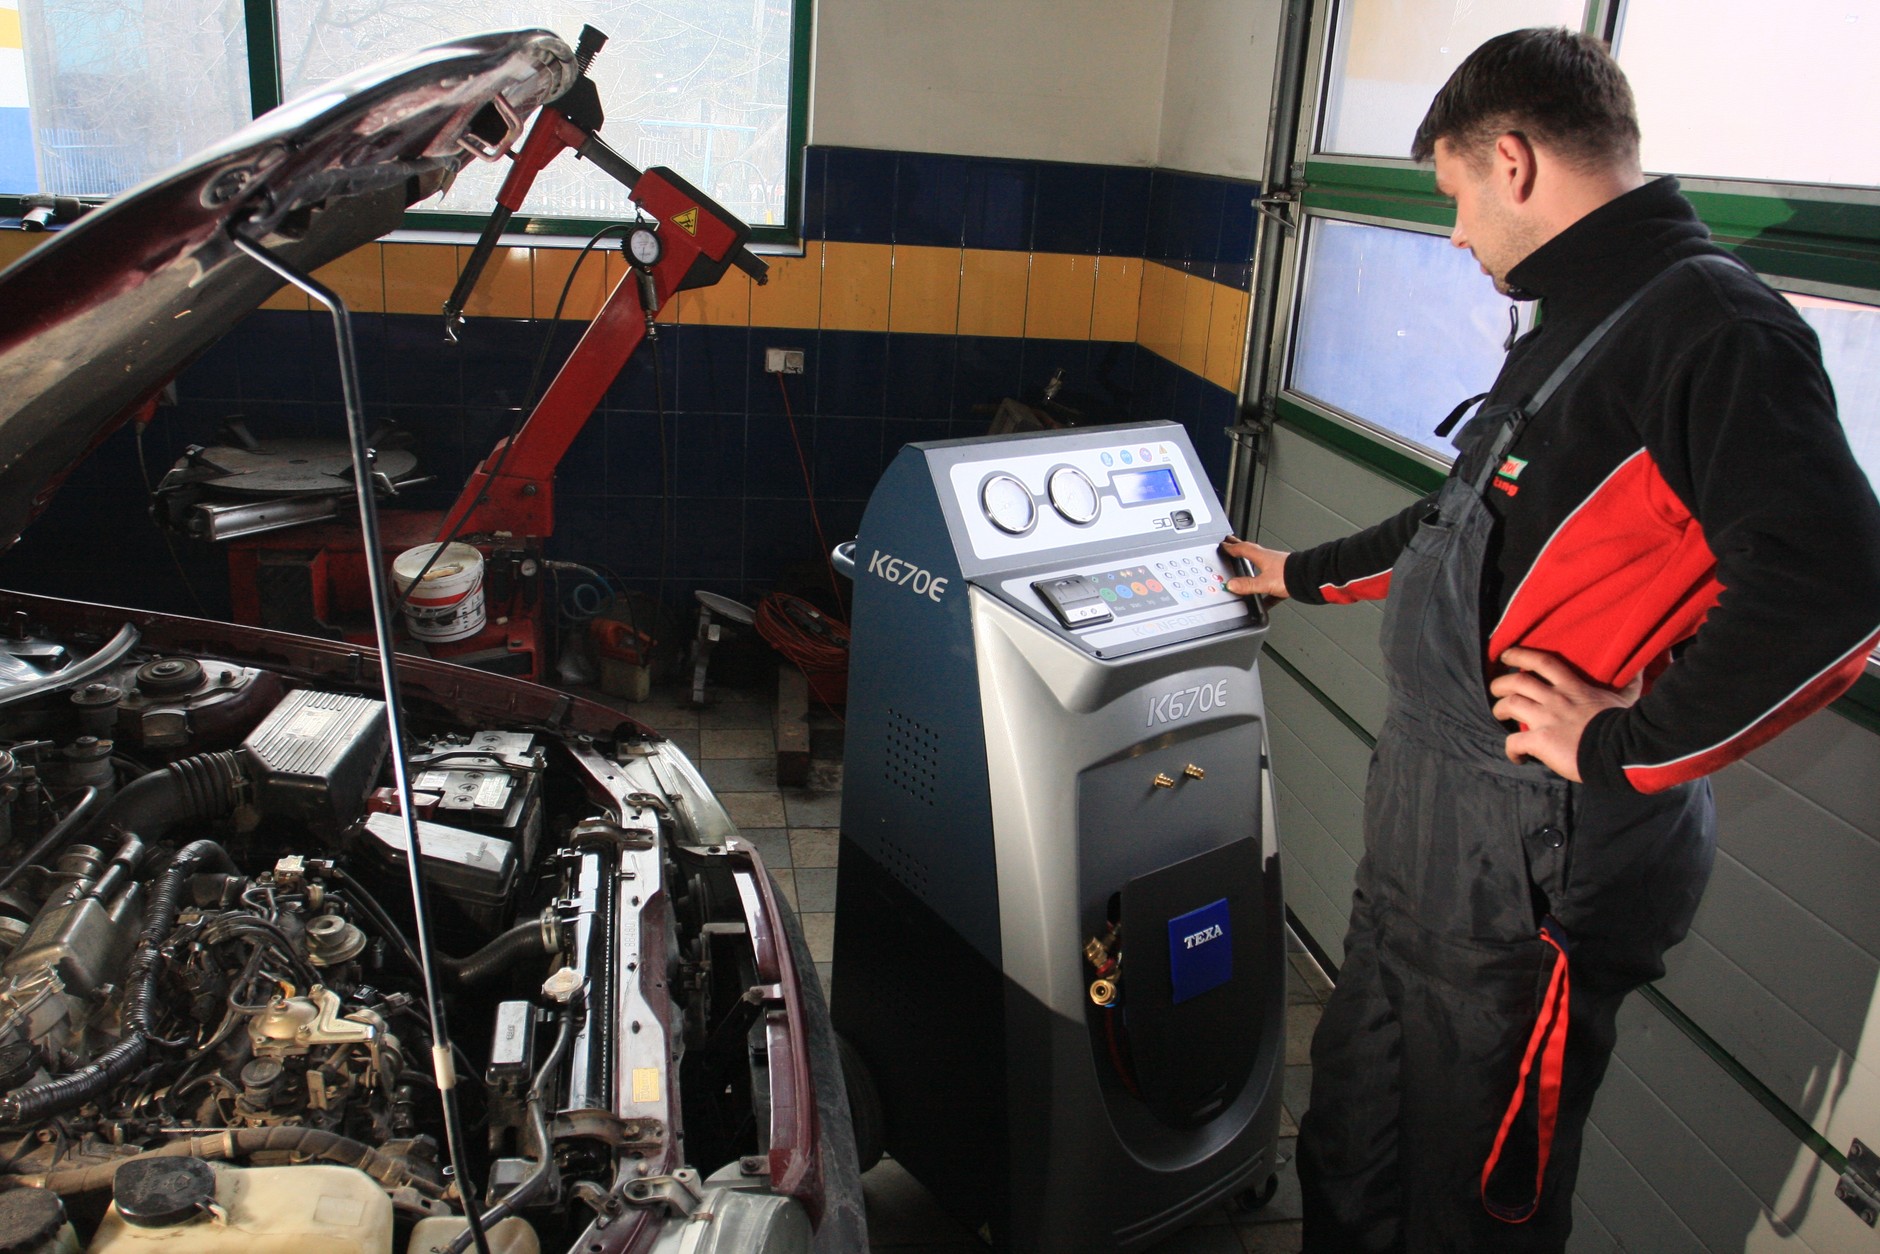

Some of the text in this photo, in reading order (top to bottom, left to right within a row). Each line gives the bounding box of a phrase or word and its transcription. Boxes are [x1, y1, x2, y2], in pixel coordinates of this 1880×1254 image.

[1152, 517, 1172, 529] SD
[867, 549, 949, 603] K670E
[1132, 613, 1206, 637] KONFORT
[1146, 678, 1228, 728] K670E
[1183, 924, 1223, 949] TEXA
